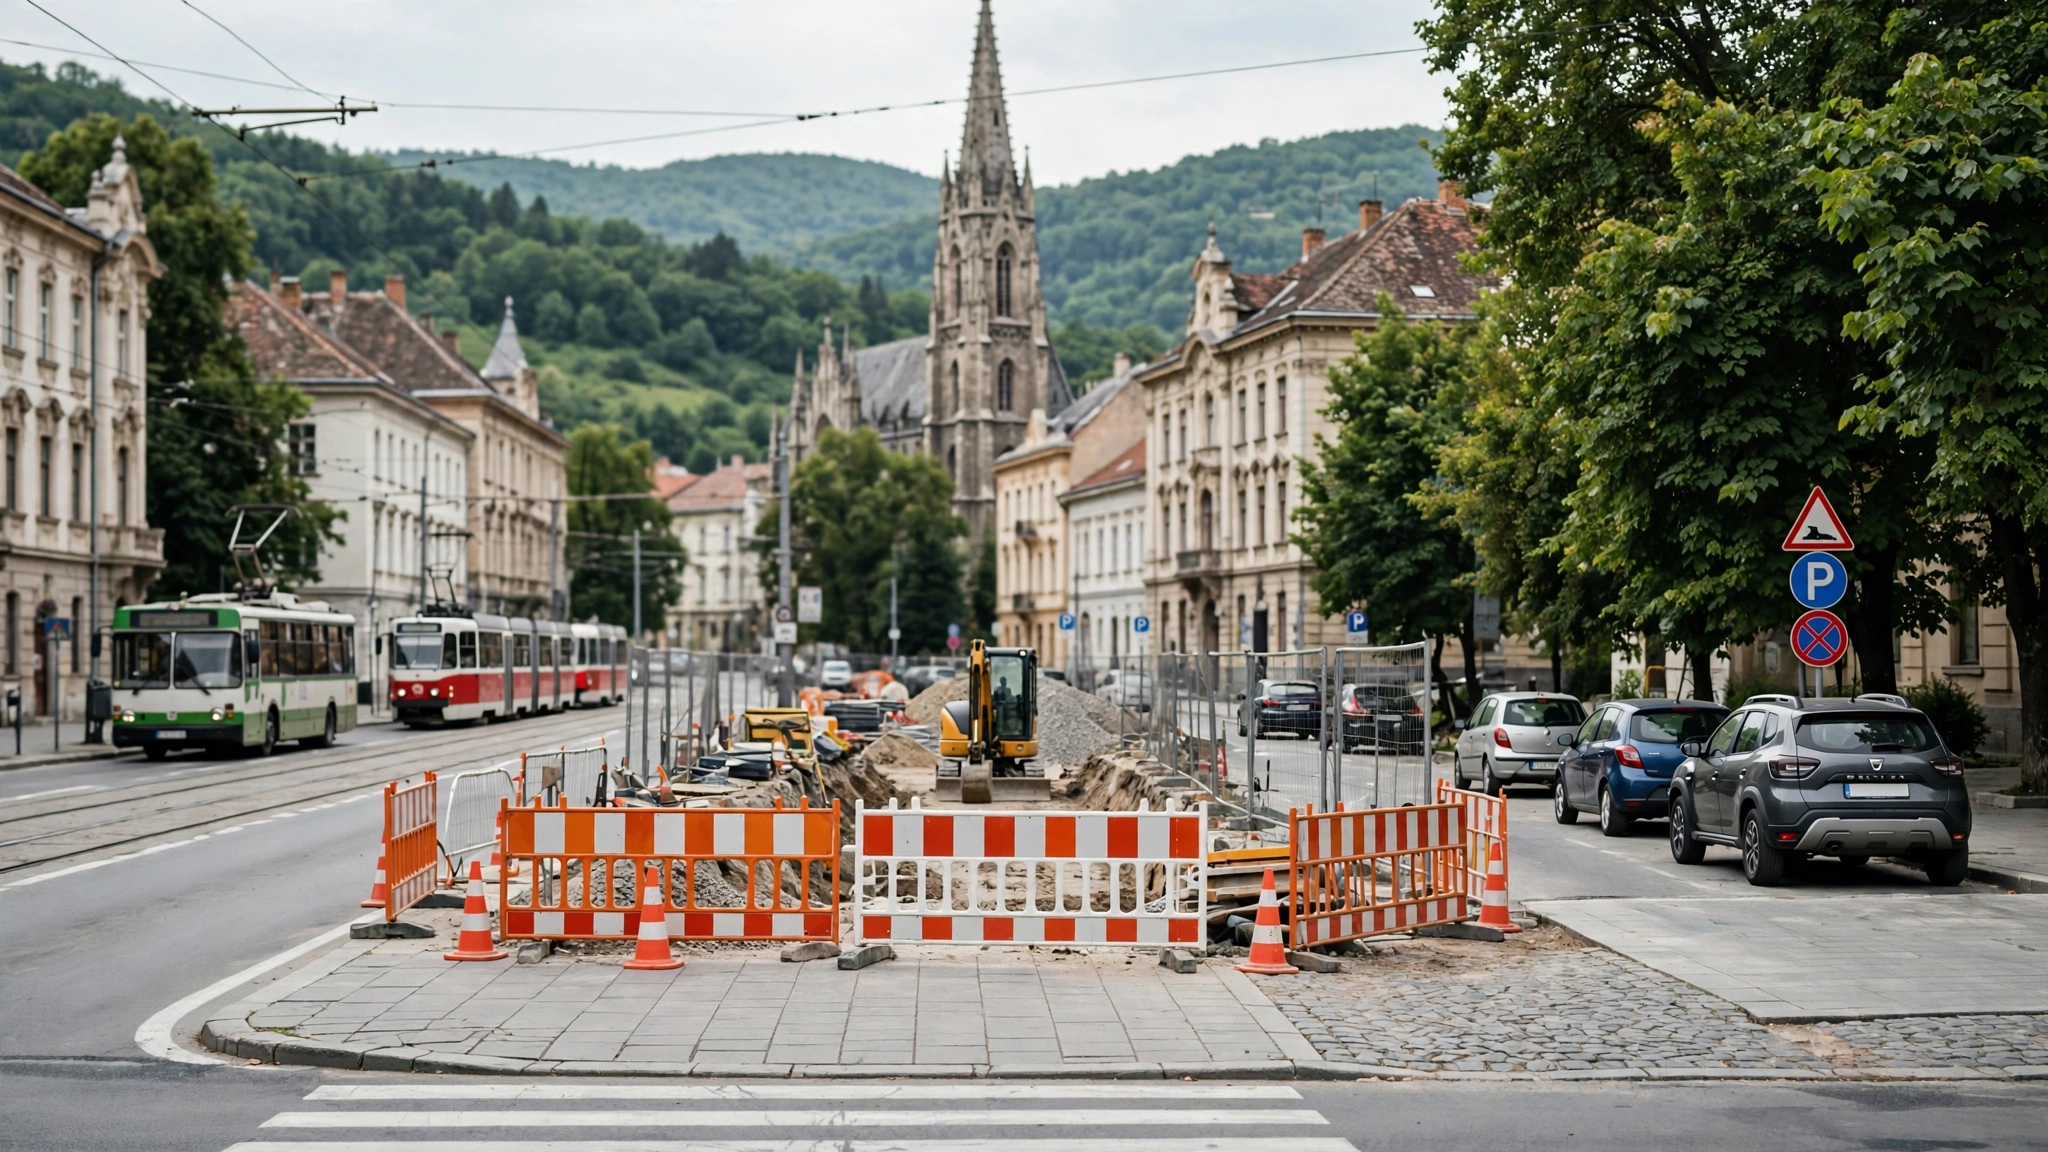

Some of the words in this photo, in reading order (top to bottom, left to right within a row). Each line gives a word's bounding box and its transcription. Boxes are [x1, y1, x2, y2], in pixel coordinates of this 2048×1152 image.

[1807, 562, 1834, 600] P
[1062, 614, 1072, 629] P
[1137, 618, 1147, 631] P
[1354, 613, 1365, 630] P
